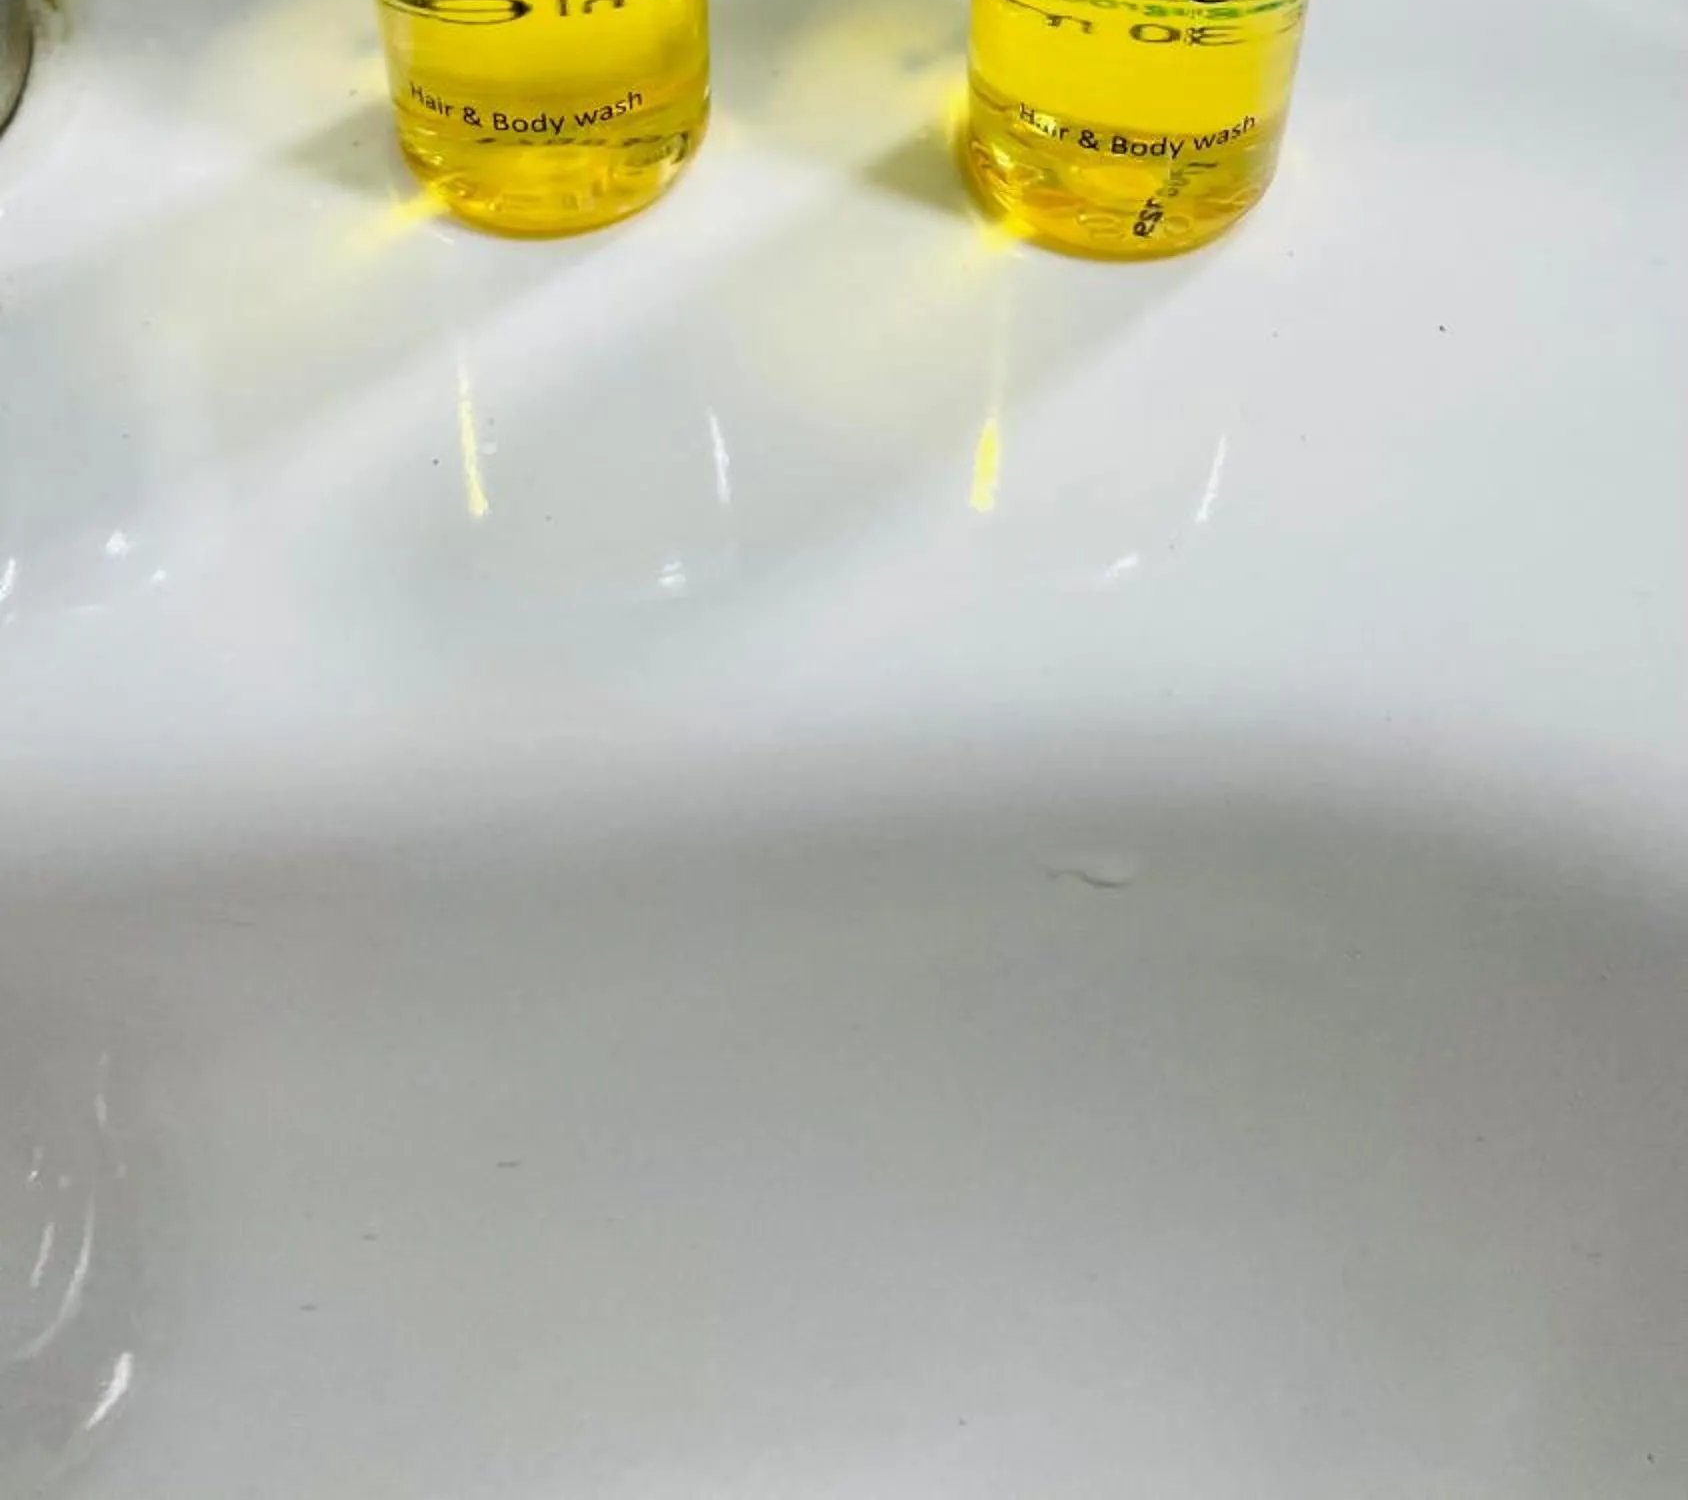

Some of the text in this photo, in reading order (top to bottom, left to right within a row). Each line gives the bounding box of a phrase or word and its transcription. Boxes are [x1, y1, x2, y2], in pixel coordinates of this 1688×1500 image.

[409, 82, 643, 136] Hair & Body wash
[1019, 101, 1257, 160] Hir & Body wash
